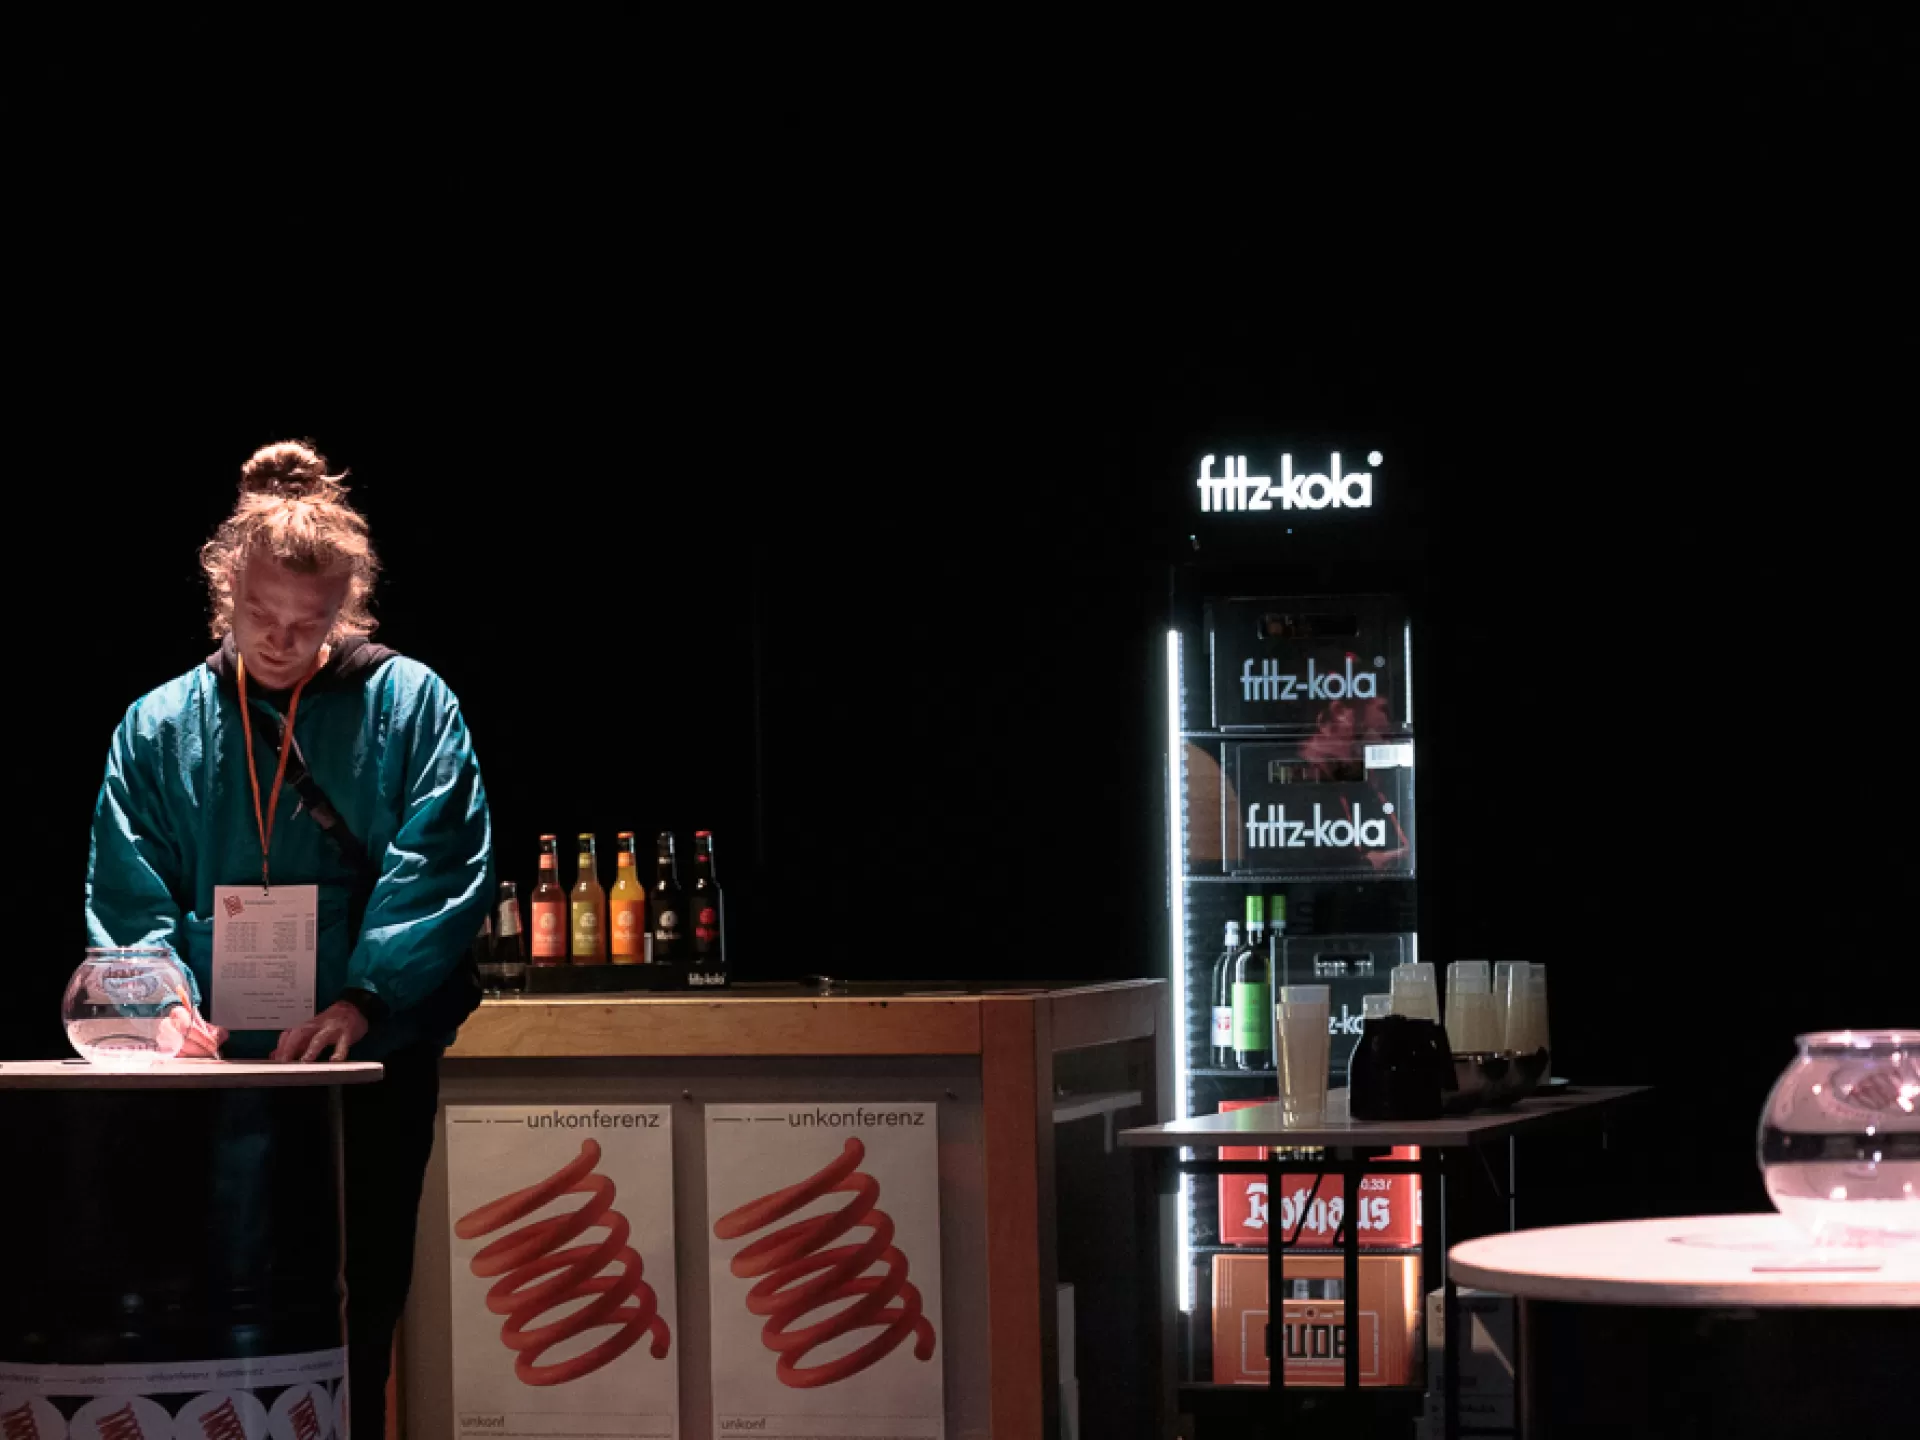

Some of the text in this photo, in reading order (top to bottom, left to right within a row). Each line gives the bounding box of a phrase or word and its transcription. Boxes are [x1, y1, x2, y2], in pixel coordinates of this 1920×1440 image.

[1197, 451, 1374, 512] fritz-kola
[1240, 657, 1377, 702] fritz-kola
[1246, 802, 1386, 848] fritz-kola
[527, 1110, 660, 1130] unkonferenz
[789, 1107, 925, 1127] unkonferenz
